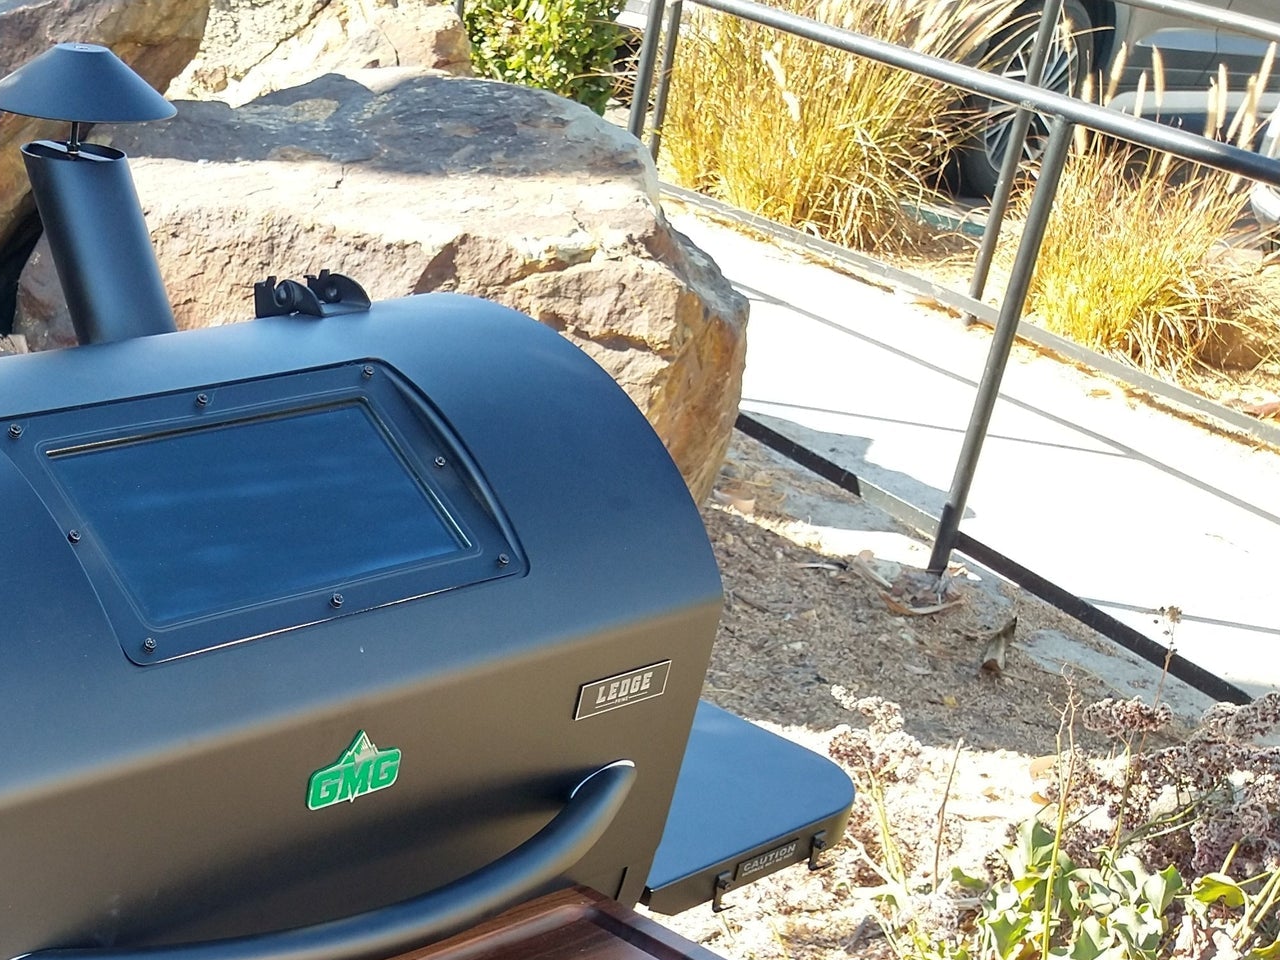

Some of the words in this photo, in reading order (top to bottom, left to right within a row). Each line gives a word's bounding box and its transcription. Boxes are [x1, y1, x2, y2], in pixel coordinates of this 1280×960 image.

[596, 671, 653, 704] LEDGE
[309, 750, 401, 809] GMG
[743, 843, 796, 872] CAUTION
